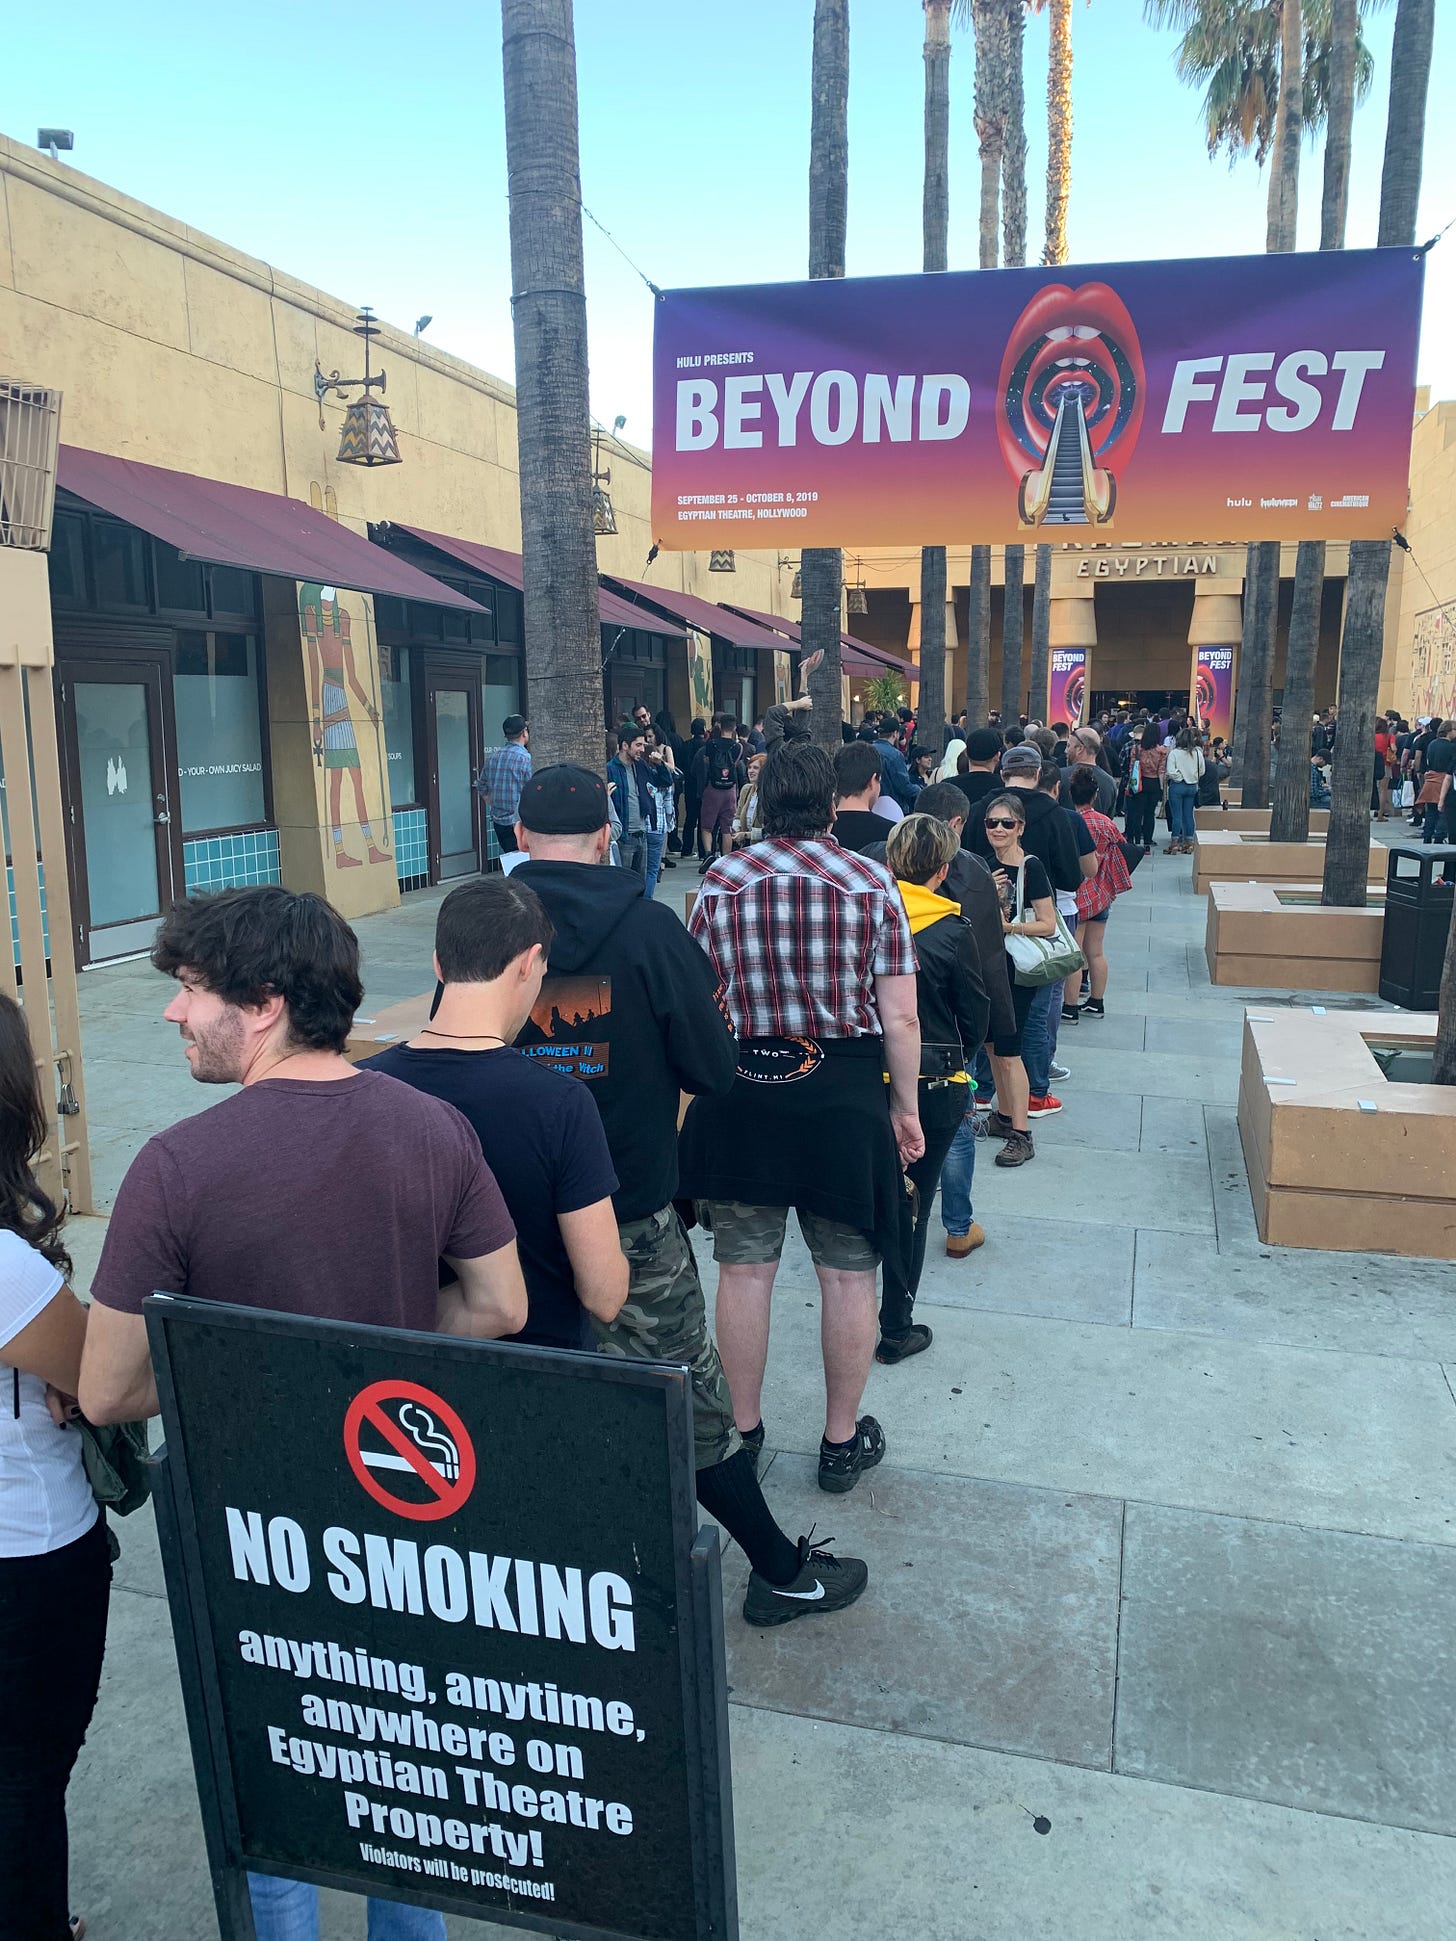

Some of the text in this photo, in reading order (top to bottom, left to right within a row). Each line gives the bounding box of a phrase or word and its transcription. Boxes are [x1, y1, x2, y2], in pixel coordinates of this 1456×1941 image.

[676, 352, 754, 369] HULU PRESENTS
[1161, 350, 1386, 433] FEST
[675, 370, 971, 452] BEYOND
[677, 494, 725, 505] SEPTEMBER
[727, 494, 738, 504] 25
[745, 492, 784, 503] OCTOBER
[786, 492, 795, 503] 8,
[796, 491, 818, 502] 2019
[1226, 497, 1253, 507] hulu
[678, 508, 807, 521] EGYPTIAN THEATRE, HOLLYWOOD
[1076, 556, 1217, 577] EGYPTIAN
[1053, 653, 1085, 662] BEYOND
[1198, 651, 1232, 660] BEYOND
[1052, 662, 1073, 671] FEST
[1210, 660, 1231, 669] FEST
[387, 752, 402, 760] SOUPS
[187, 766, 205, 776] YOUR
[208, 765, 225, 775] OWN
[225, 764, 242, 773] JUICY
[242, 763, 262, 772] SALAD
[225, 1506, 637, 1652] NO SMOKING
[238, 1630, 646, 1743] anything, anytime,
[301, 1692, 584, 1780] anywhere on
[267, 1724, 634, 1836] Egyptian Theatre
[344, 1790, 545, 1869] Property!
[359, 1842, 555, 1902] Violators will be prosecuted!
